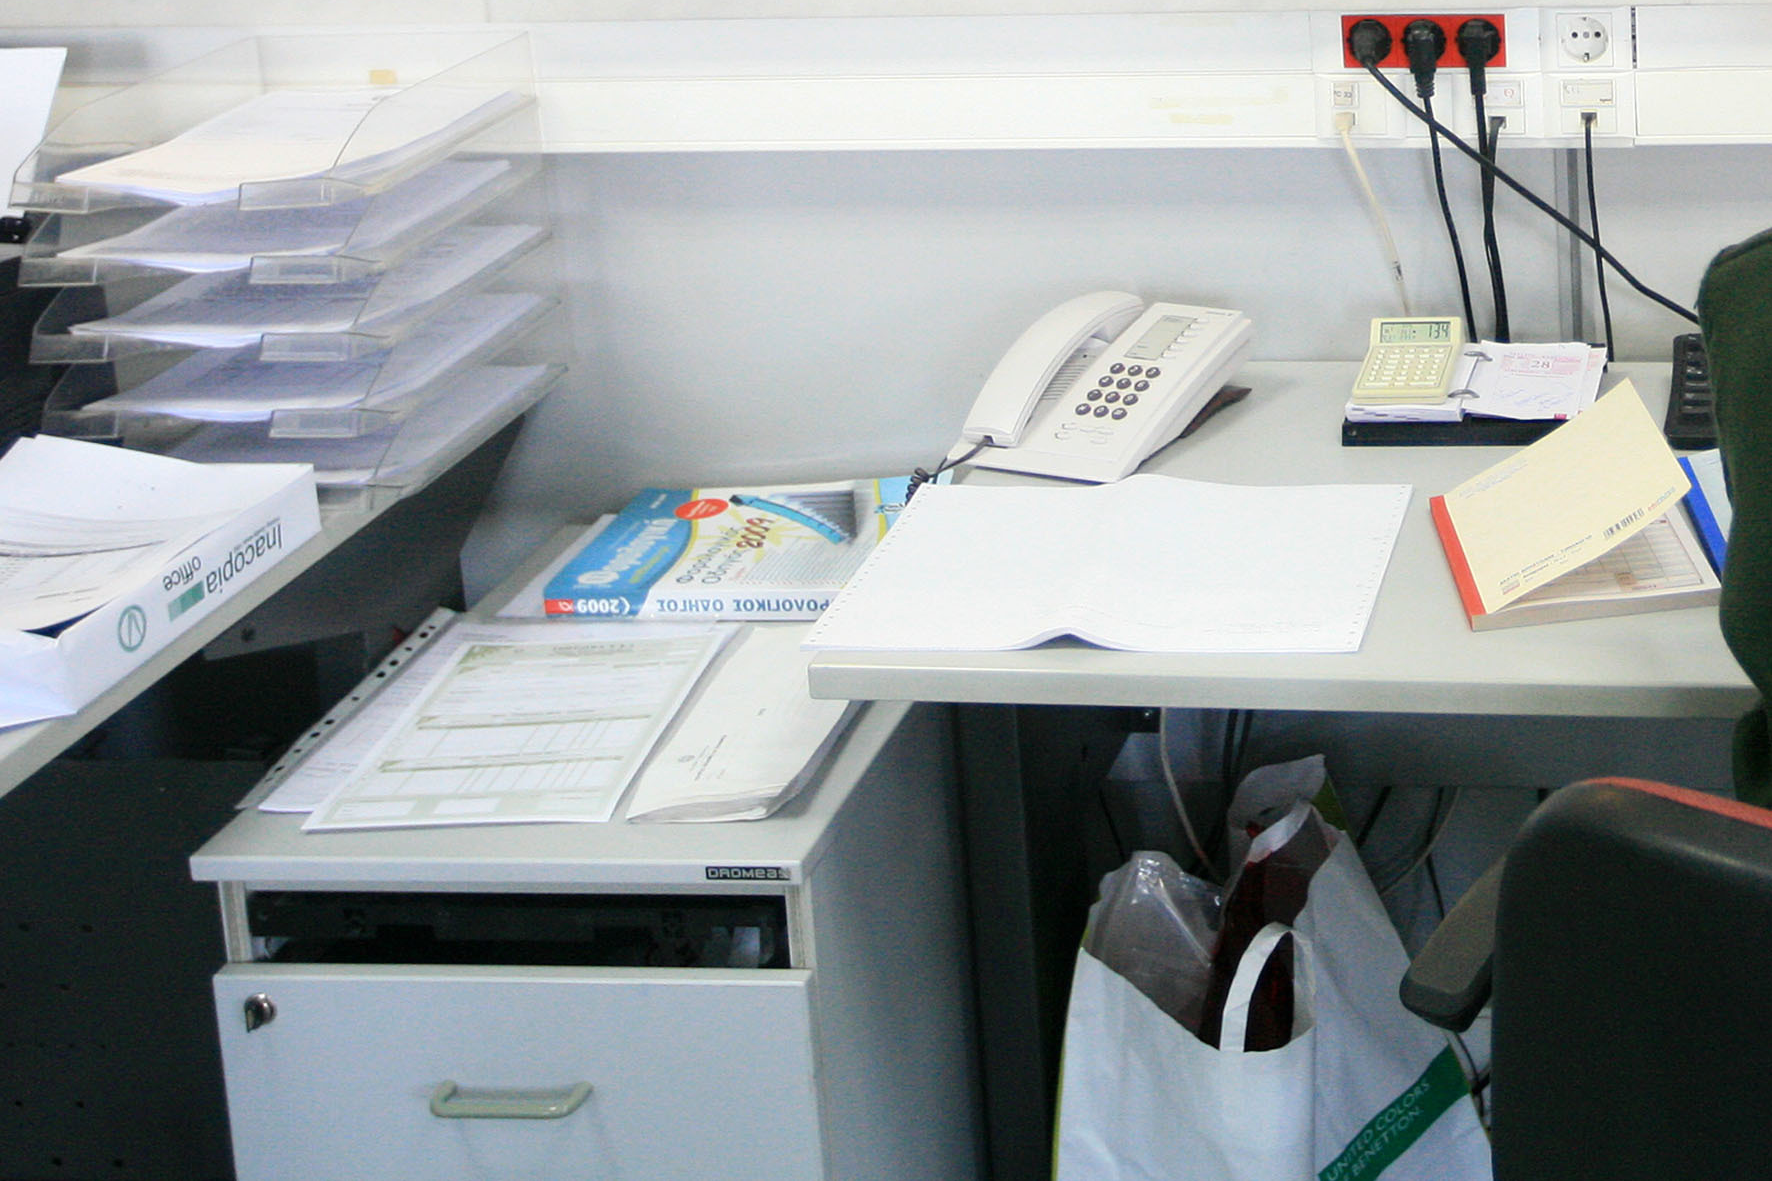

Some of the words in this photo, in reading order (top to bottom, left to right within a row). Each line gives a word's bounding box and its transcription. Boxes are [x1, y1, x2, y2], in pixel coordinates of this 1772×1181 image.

[162, 554, 202, 592] office
[205, 523, 283, 595] Inacopia
[656, 599, 724, 613] ΟΔΗΓΟΣ
[733, 598, 830, 613] ΡΟΛΟΓΙΚΟΣ
[1374, 1080, 1430, 1131] COLORS
